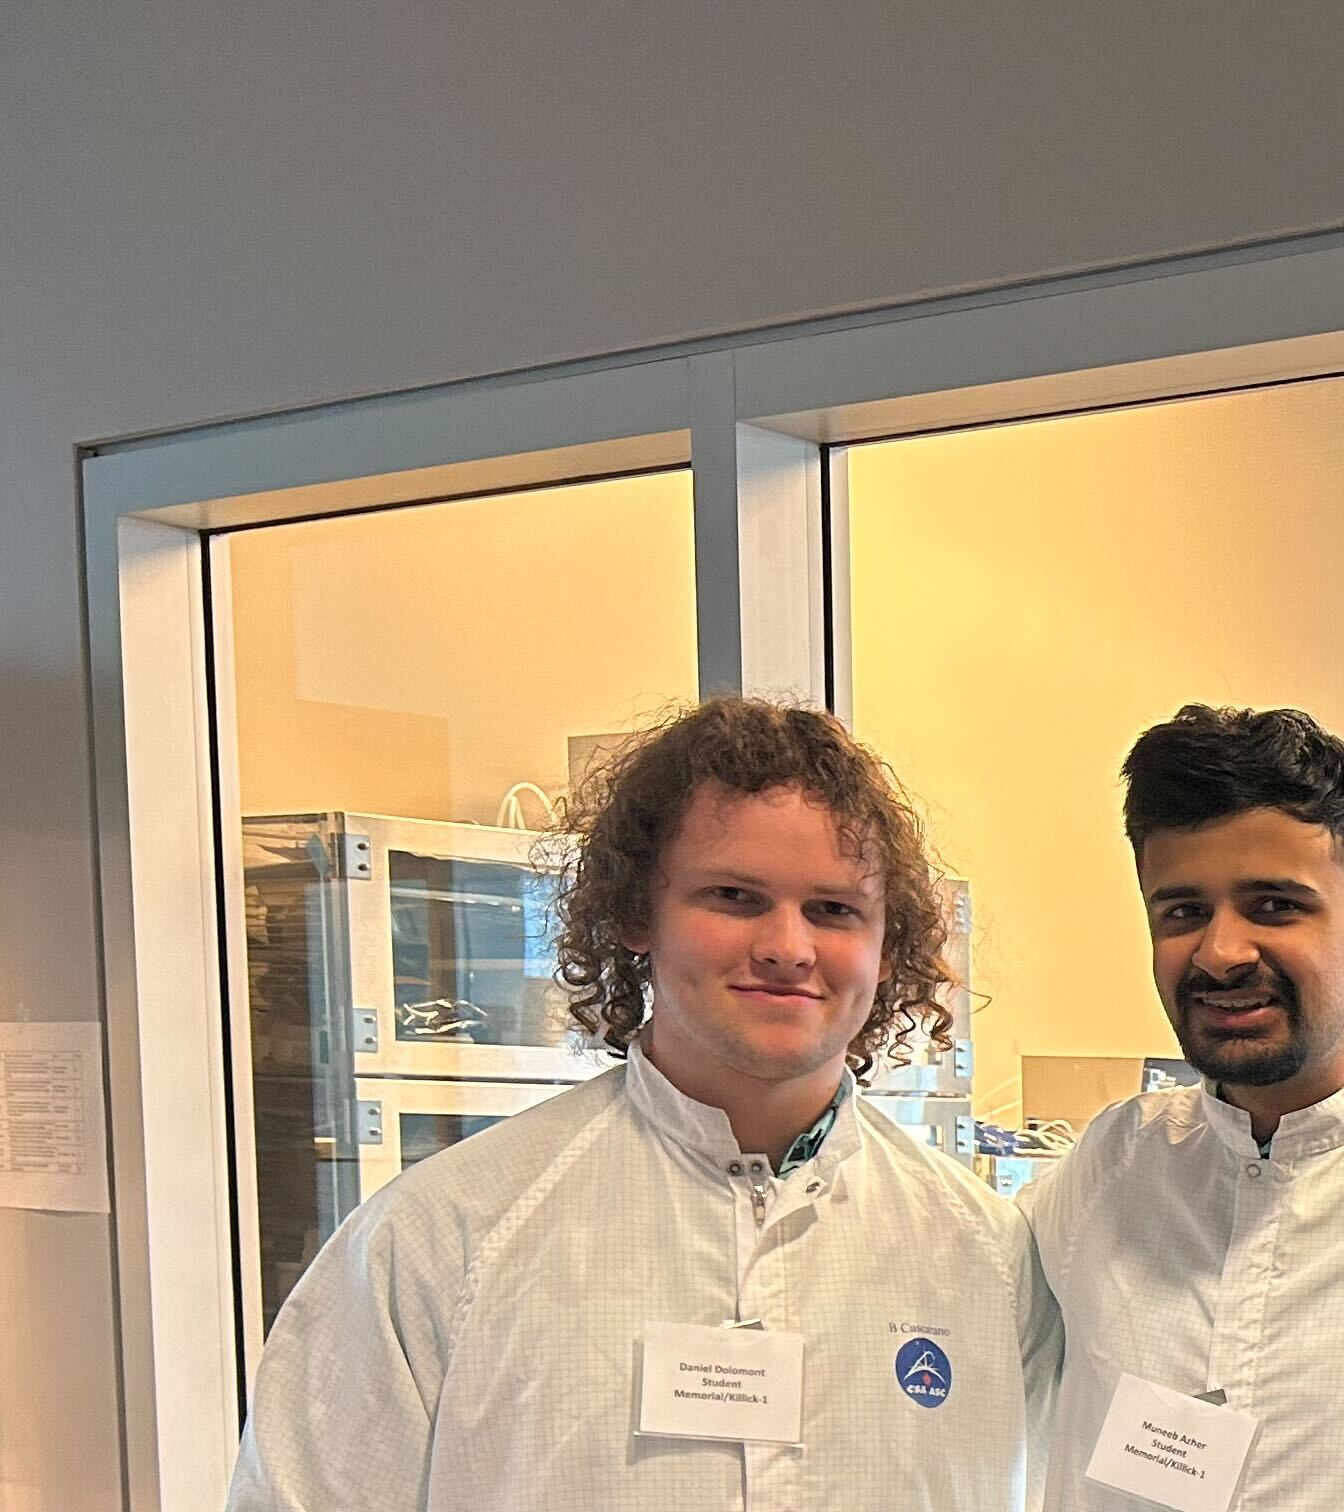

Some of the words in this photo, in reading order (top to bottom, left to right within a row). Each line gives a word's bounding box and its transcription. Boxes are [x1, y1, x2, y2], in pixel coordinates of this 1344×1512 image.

[679, 1361, 712, 1374] Daniel
[701, 1377, 742, 1389] Student
[673, 1389, 768, 1404] Memorial/Killick-1
[906, 1384, 927, 1395] CSA
[928, 1386, 947, 1398] ASC
[1141, 1420, 1179, 1441] Muneeb
[1151, 1438, 1188, 1458] Student
[1124, 1443, 1206, 1479] Memorial/Killick-1
